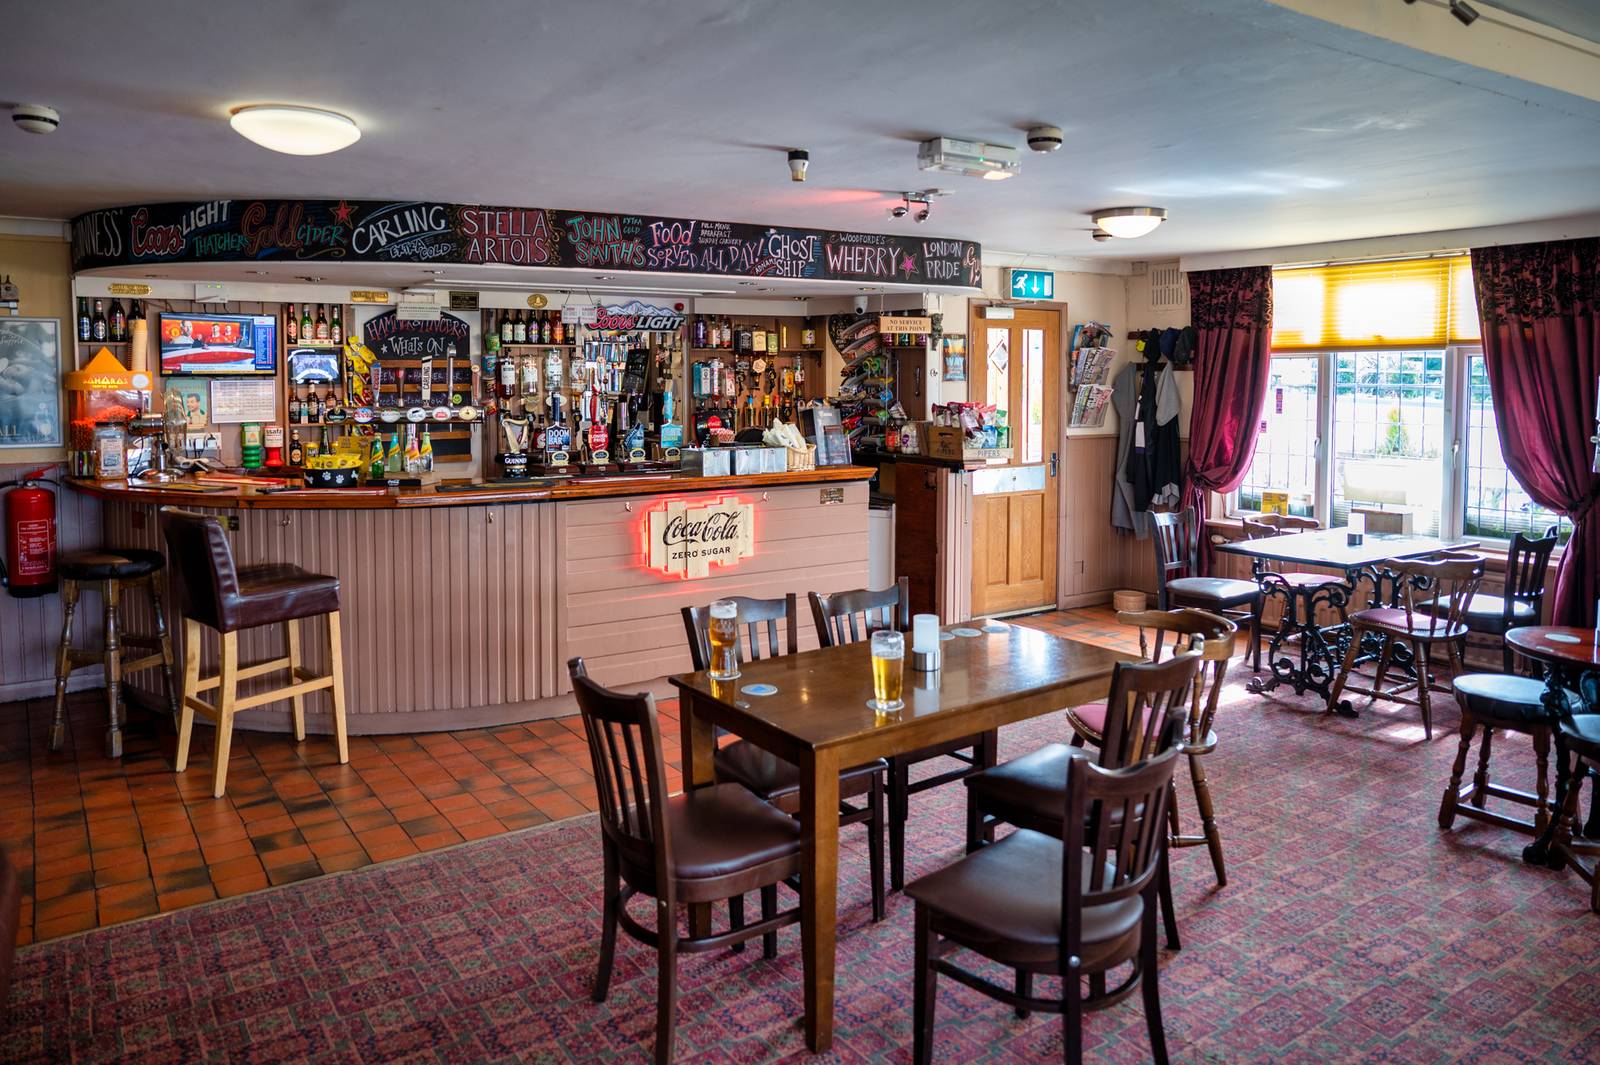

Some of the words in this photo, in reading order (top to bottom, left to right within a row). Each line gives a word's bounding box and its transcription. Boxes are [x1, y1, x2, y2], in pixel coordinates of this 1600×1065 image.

[131, 207, 186, 257] Coors
[183, 200, 232, 234] LIGHT
[193, 232, 251, 257] THATCHERS
[240, 201, 304, 257] Gold
[297, 223, 349, 247] CIDER
[352, 205, 446, 254] CARLING
[463, 210, 548, 237] STELLA
[566, 215, 622, 244] JOHN
[700, 229, 732, 238] BREAKFAST
[390, 239, 427, 259] EXTRA
[419, 243, 451, 260] COLD
[468, 237, 548, 264] ARTOIS
[768, 233, 818, 263] GHOST
[839, 233, 887, 245] WOODFORDE'S
[923, 241, 963, 258] LONDON
[700, 246, 728, 272] ALL
[728, 238, 765, 272] DAY!
[825, 244, 901, 276] WHERRY
[776, 259, 806, 278] SHIP
[926, 260, 960, 280] PRIDE
[588, 307, 638, 331] Coors
[635, 315, 685, 330] LIGHT
[427, 337, 445, 356] ON
[422, 365, 431, 391] CARLING
[549, 429, 570, 437] DOOM
[549, 436, 563, 445] BAR
[663, 511, 741, 546] Coca-Cola
[672, 550, 699, 560] ZERO
[701, 546, 731, 557] SUGAR
